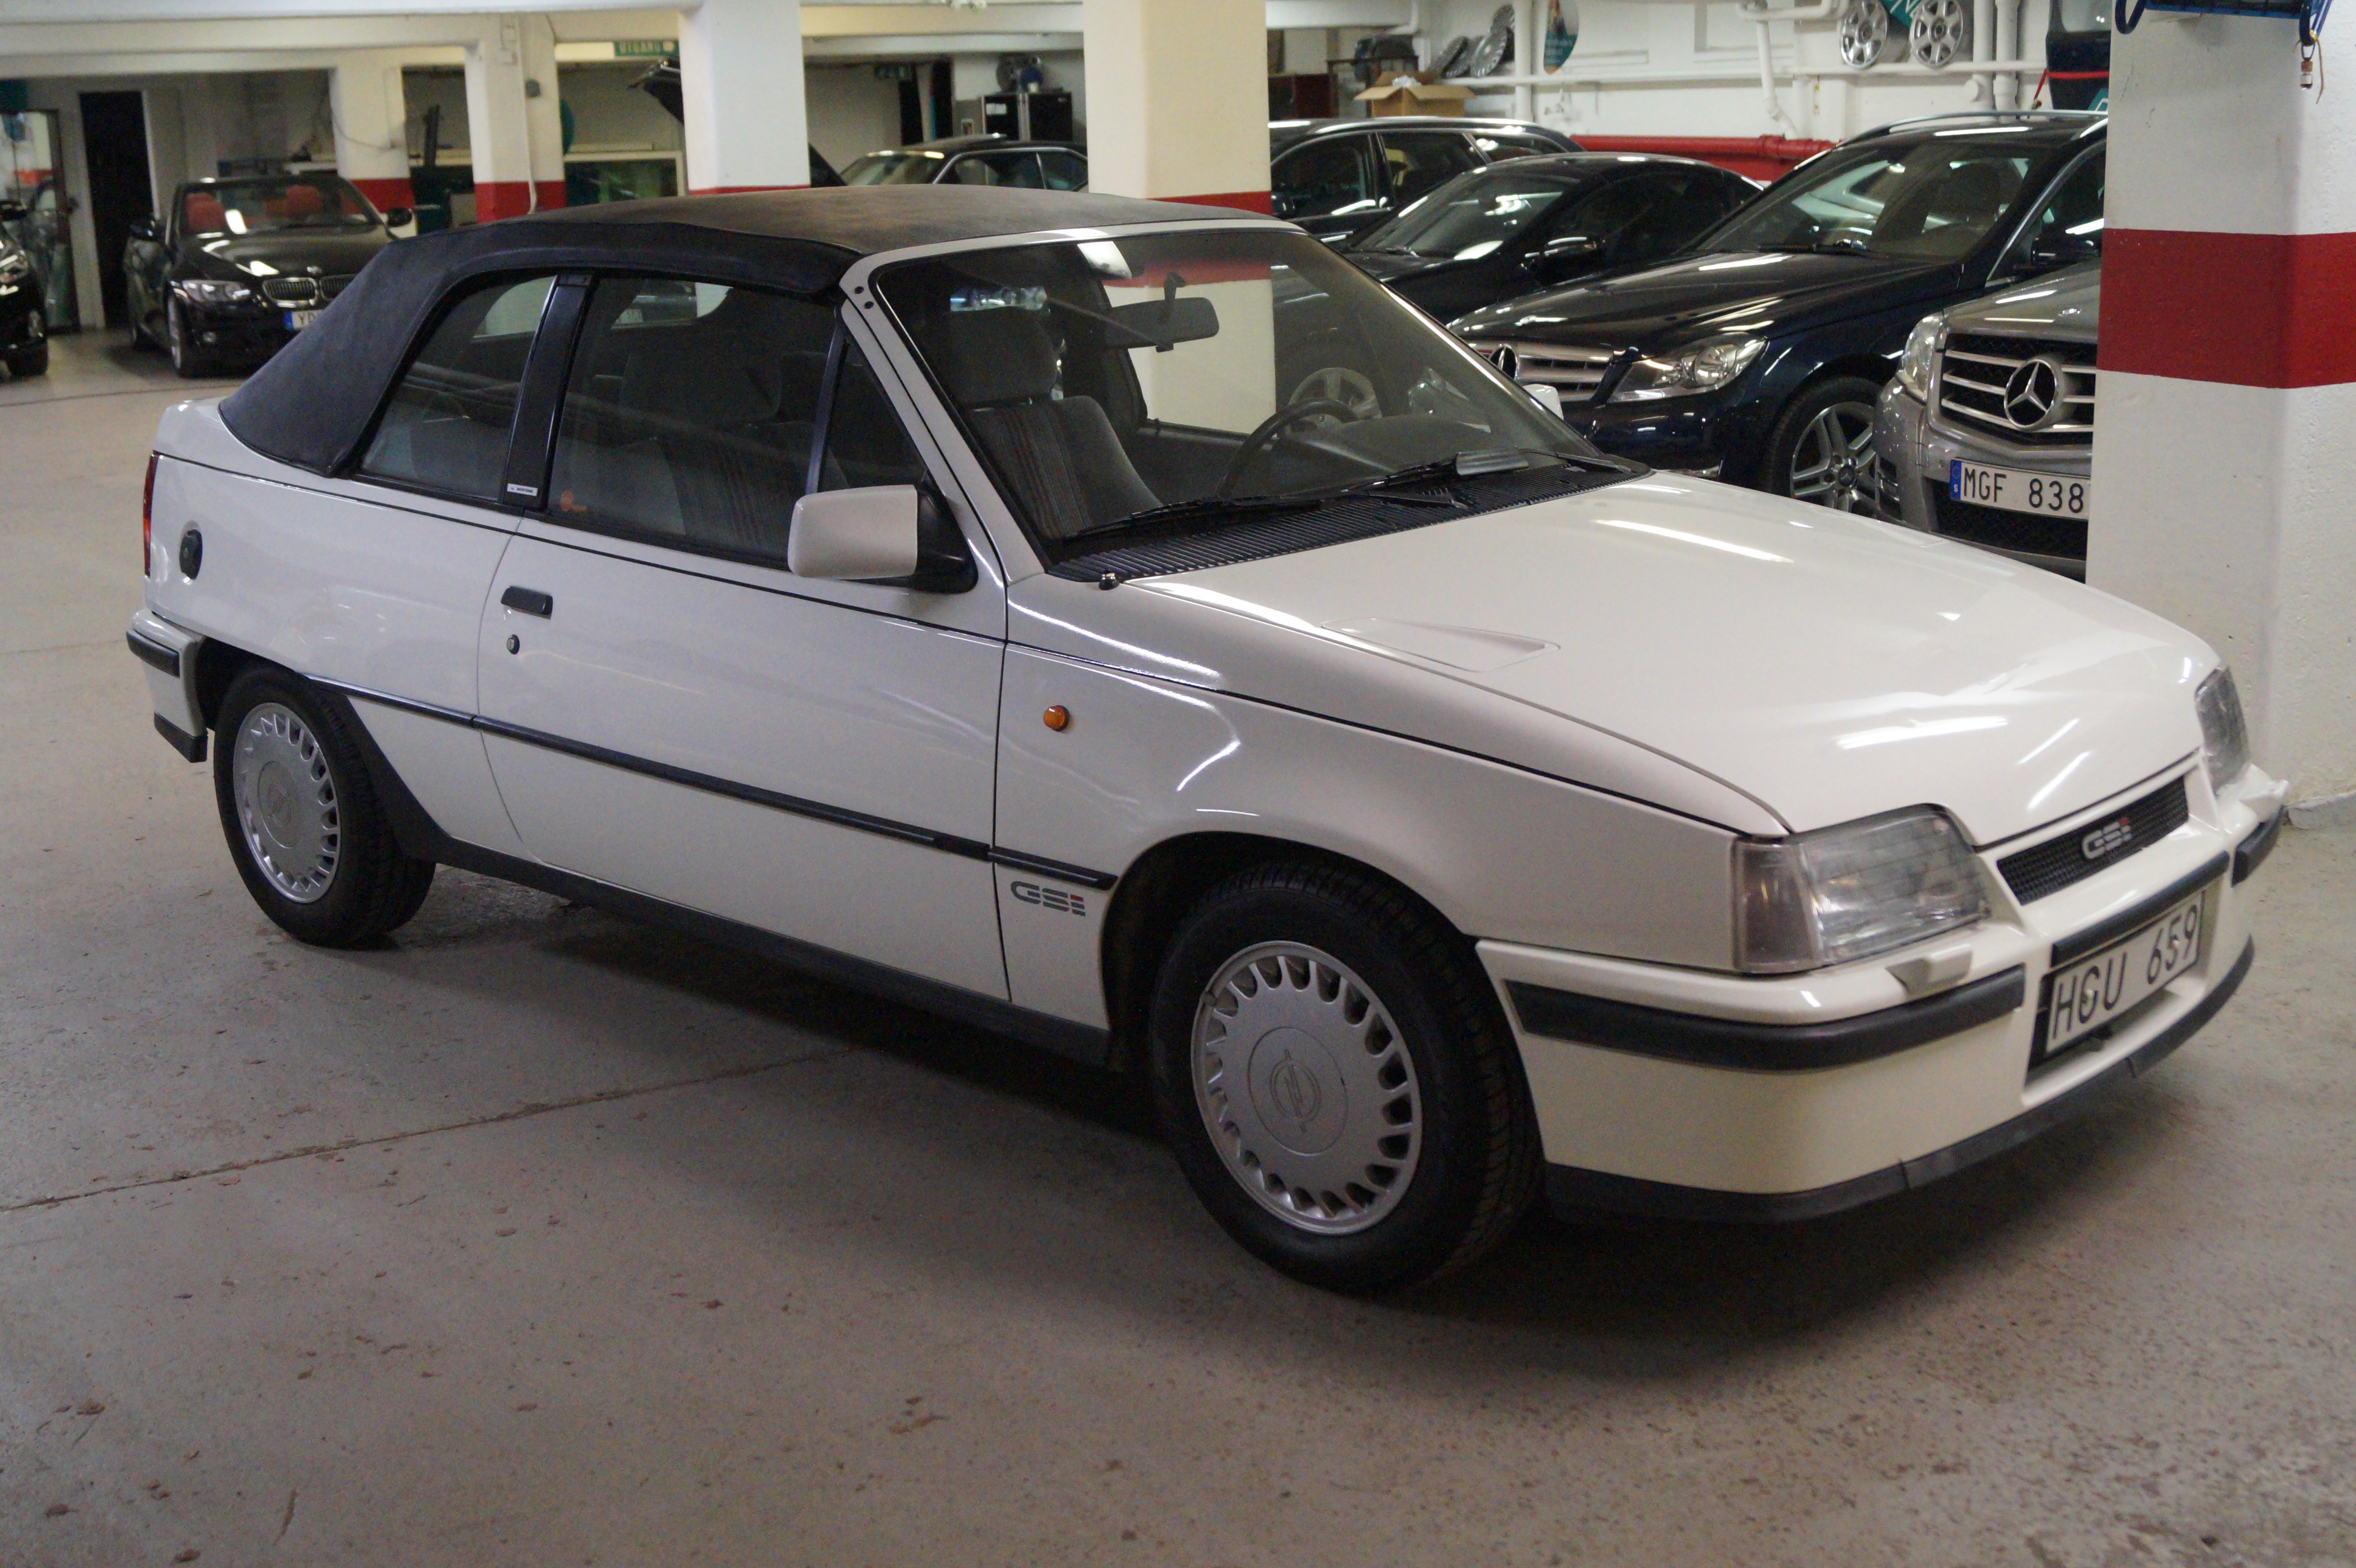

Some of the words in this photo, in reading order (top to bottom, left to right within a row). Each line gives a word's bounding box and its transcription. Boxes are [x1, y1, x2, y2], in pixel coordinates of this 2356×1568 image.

[297, 312, 316, 325] YD
[1954, 484, 1958, 493] S
[1963, 467, 2006, 503] MGF
[2029, 478, 2084, 513] 838
[2053, 951, 2128, 1040] HGU
[2147, 904, 2197, 985] 659
